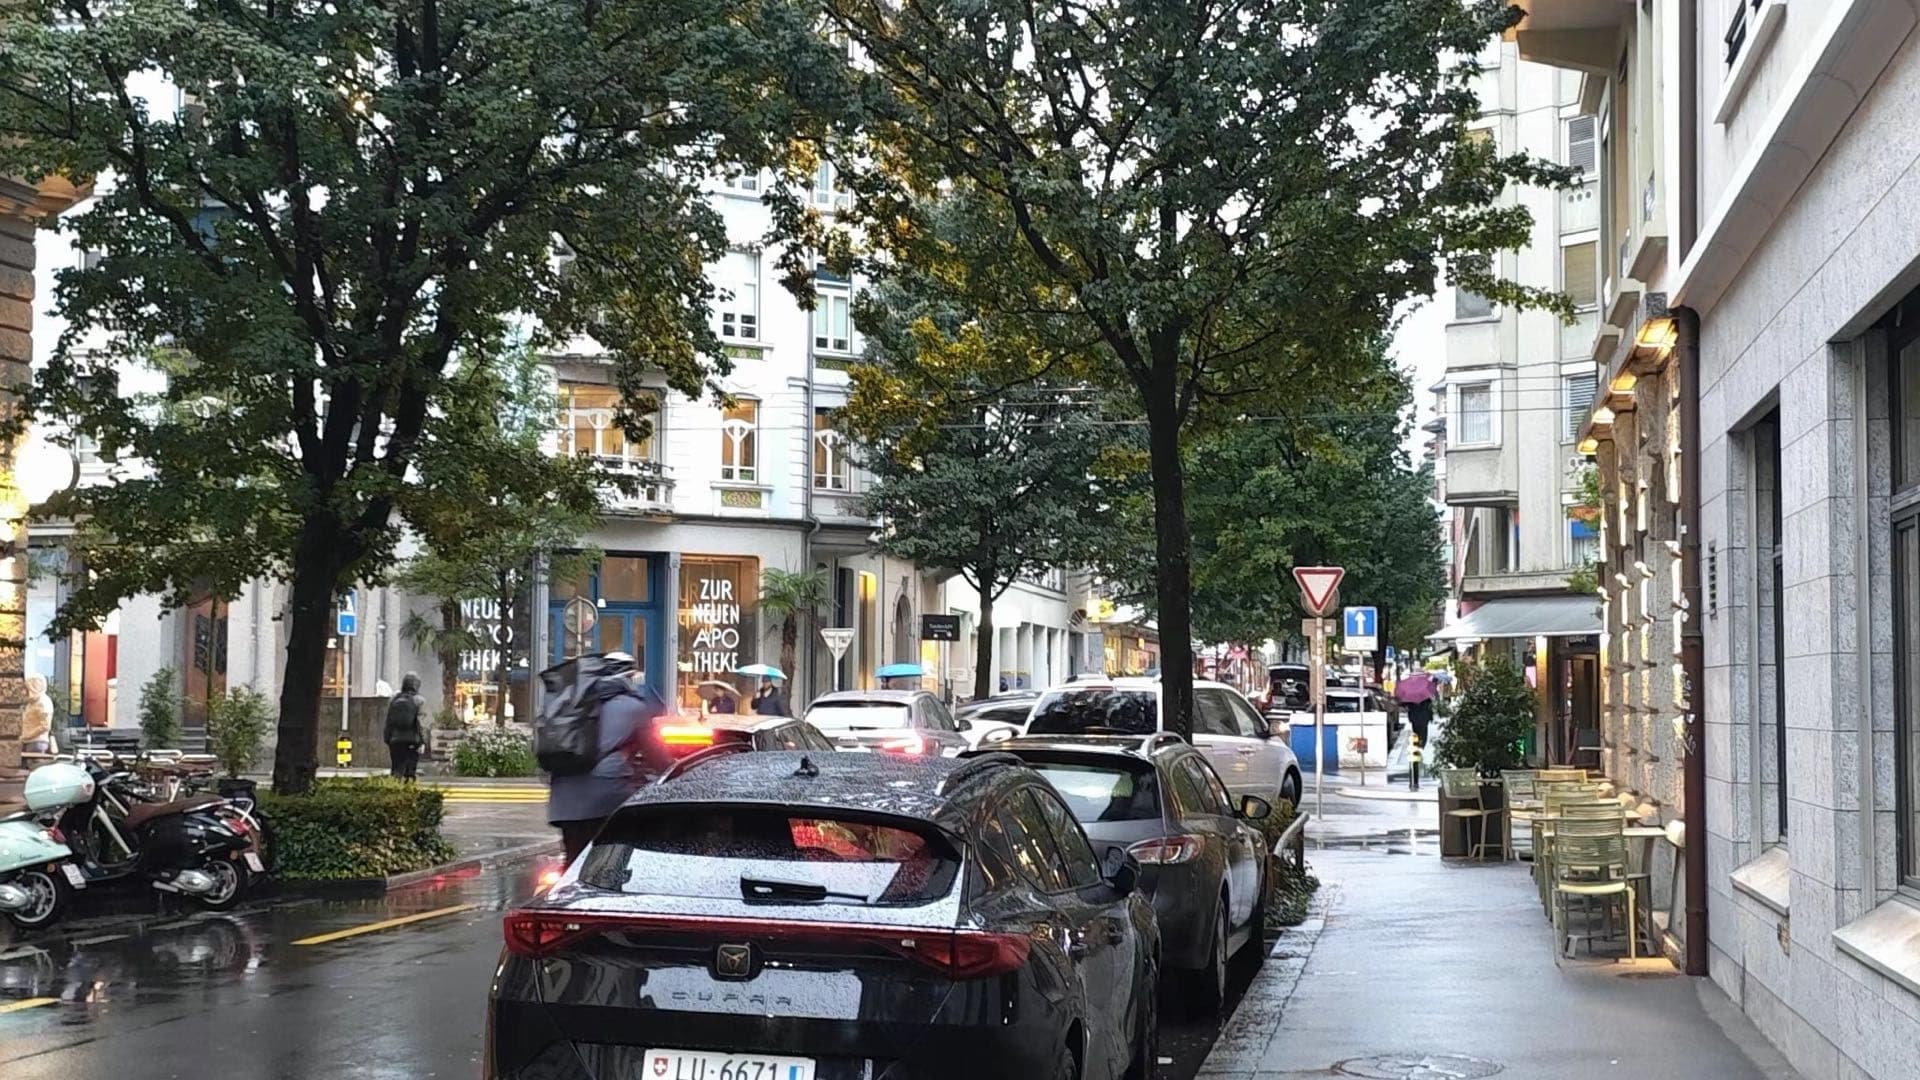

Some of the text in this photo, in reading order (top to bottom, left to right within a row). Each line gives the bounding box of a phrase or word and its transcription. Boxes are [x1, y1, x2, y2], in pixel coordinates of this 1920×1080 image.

[700, 579, 733, 600] ZUR
[692, 604, 740, 624] NEUEN
[693, 628, 739, 648] APO
[693, 652, 738, 672] THEKE
